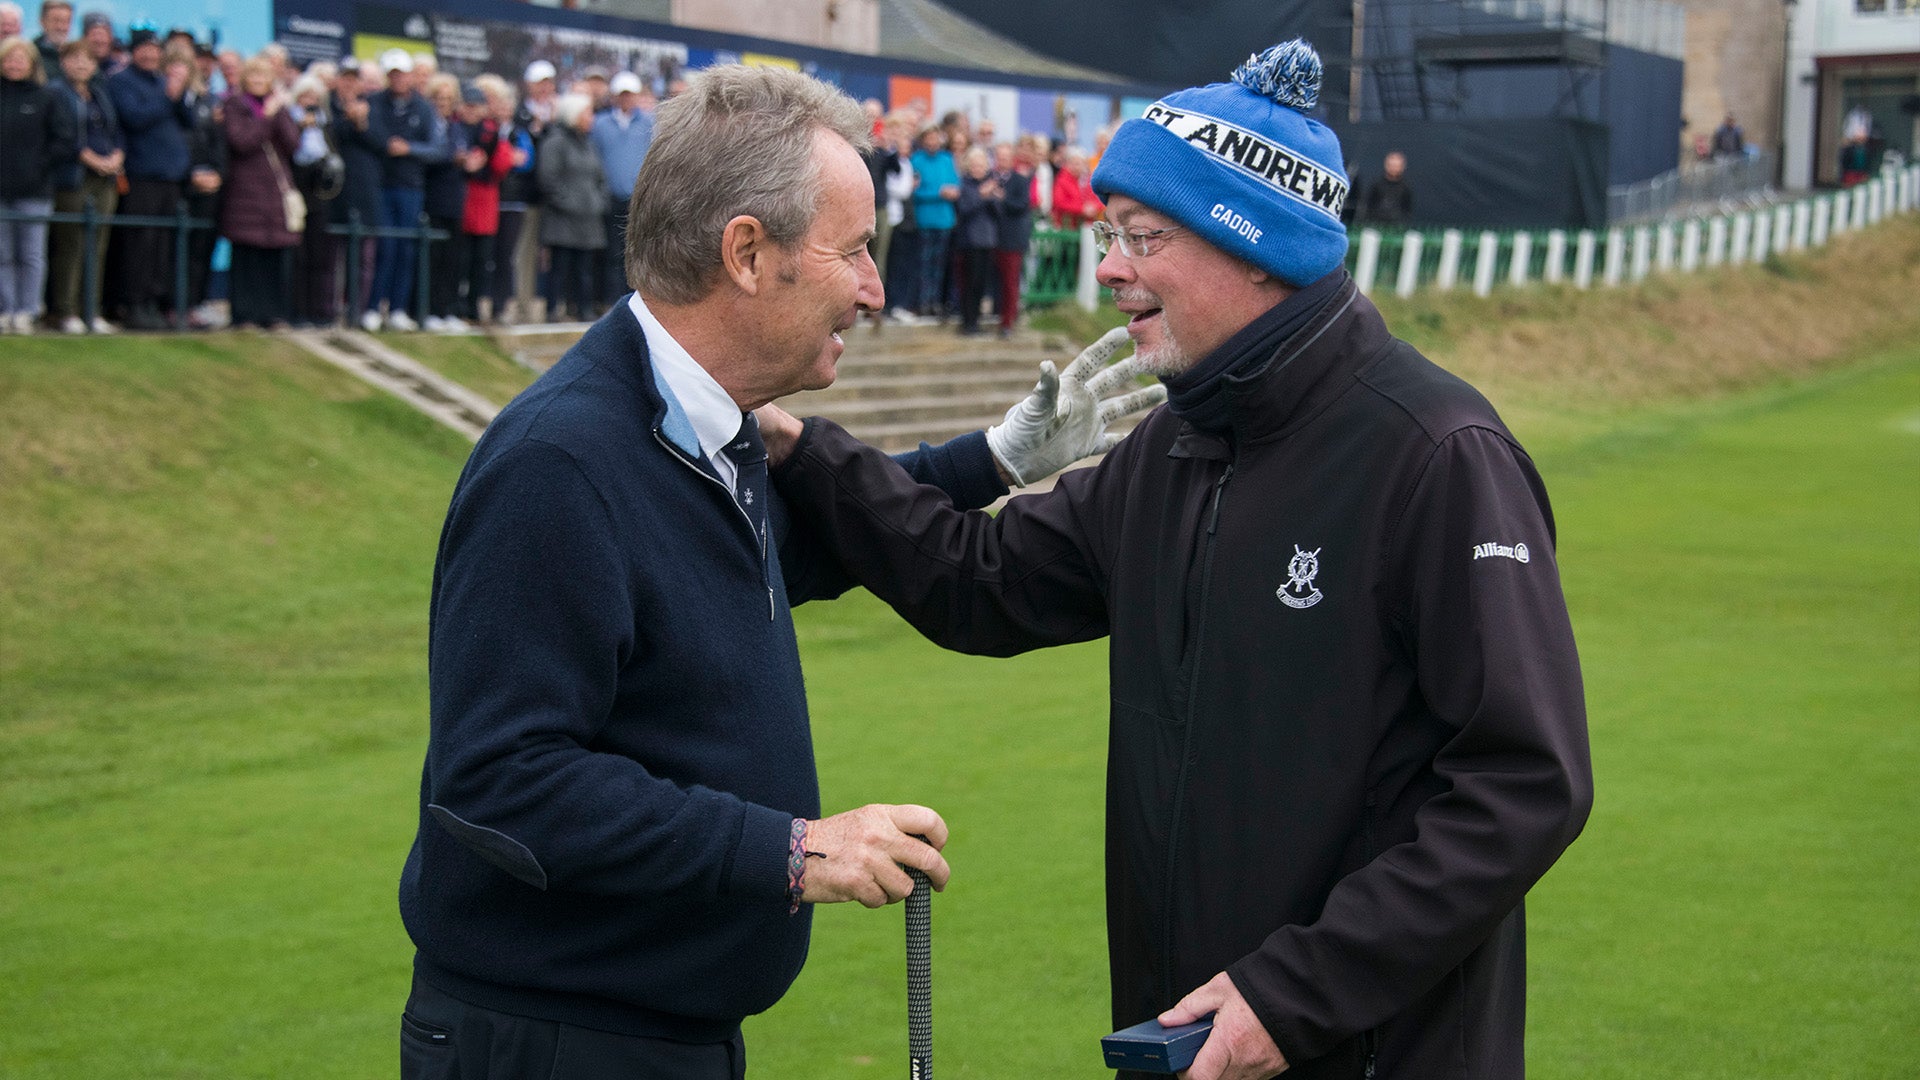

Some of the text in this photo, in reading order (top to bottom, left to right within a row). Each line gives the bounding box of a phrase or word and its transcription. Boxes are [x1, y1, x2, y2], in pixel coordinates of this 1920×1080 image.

[1184, 122, 1346, 216] ANDREWS
[1210, 203, 1264, 245] CADDIE
[1473, 542, 1515, 560] Allianz
